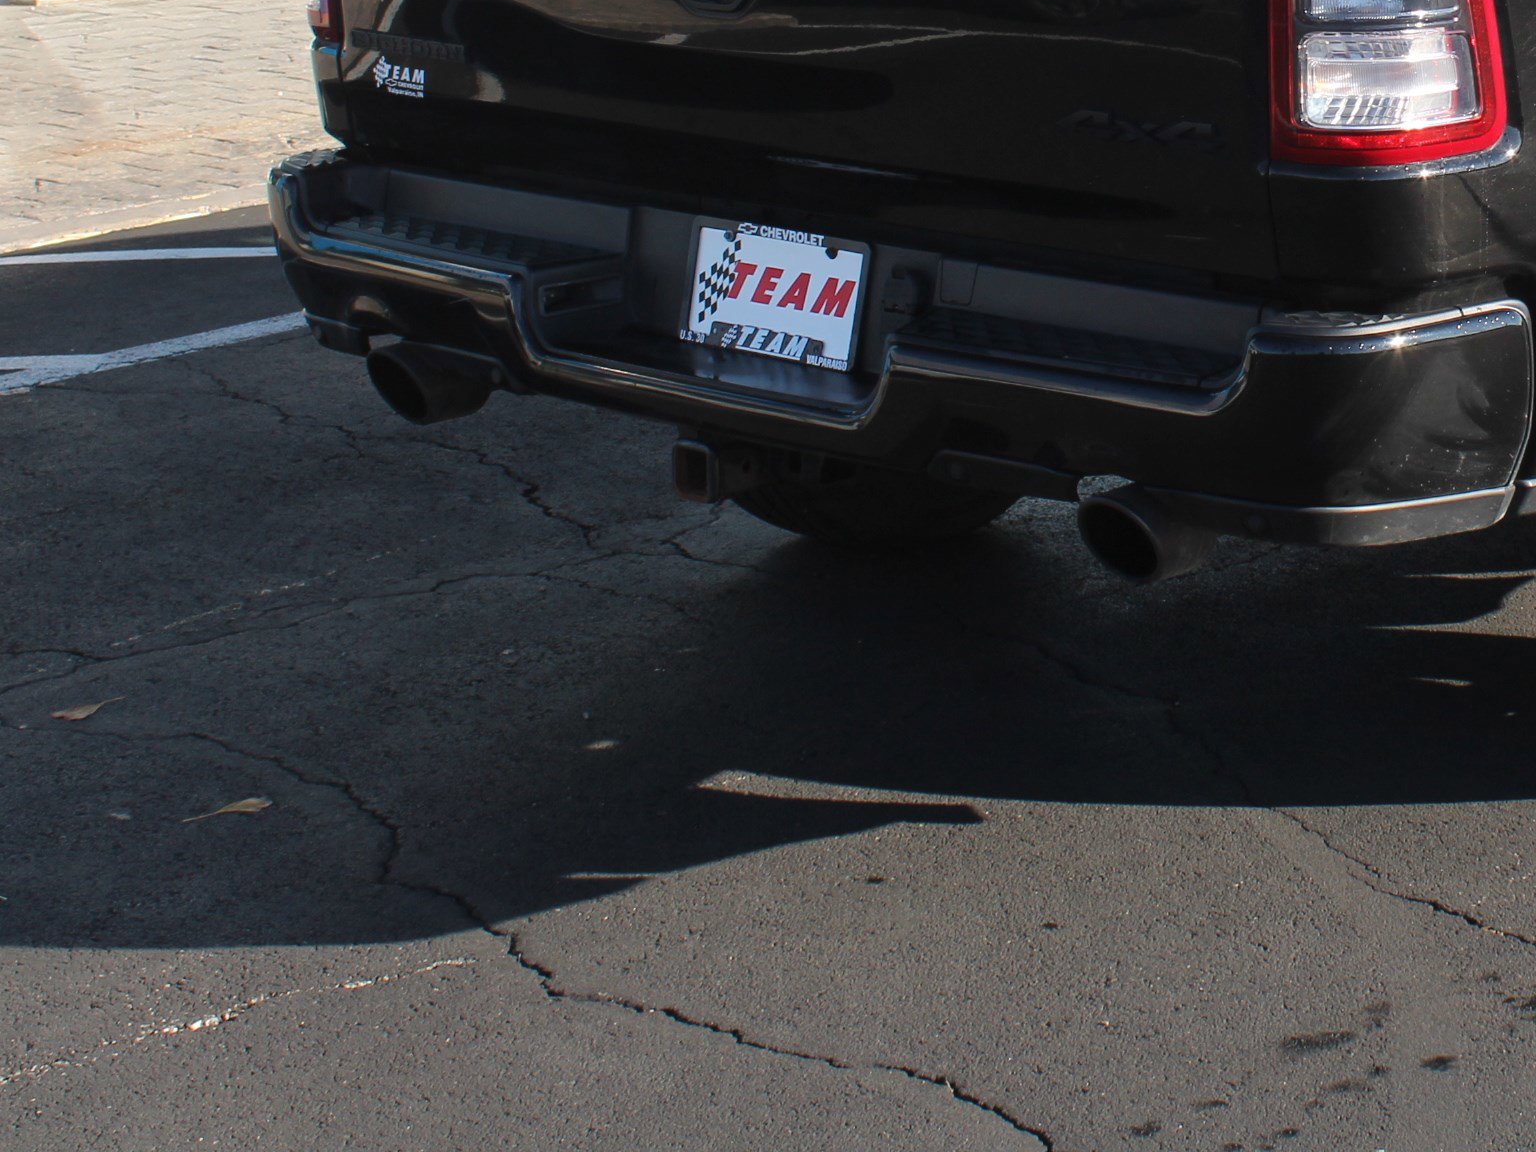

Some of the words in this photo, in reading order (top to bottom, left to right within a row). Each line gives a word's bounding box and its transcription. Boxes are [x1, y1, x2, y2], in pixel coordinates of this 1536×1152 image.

[385, 62, 425, 84] TEAM
[759, 225, 824, 247] CHEVROLET
[727, 262, 857, 318] TEAM
[679, 328, 695, 342] U.S.
[737, 325, 810, 358] TEAM
[806, 353, 848, 372] VALPARAISO
